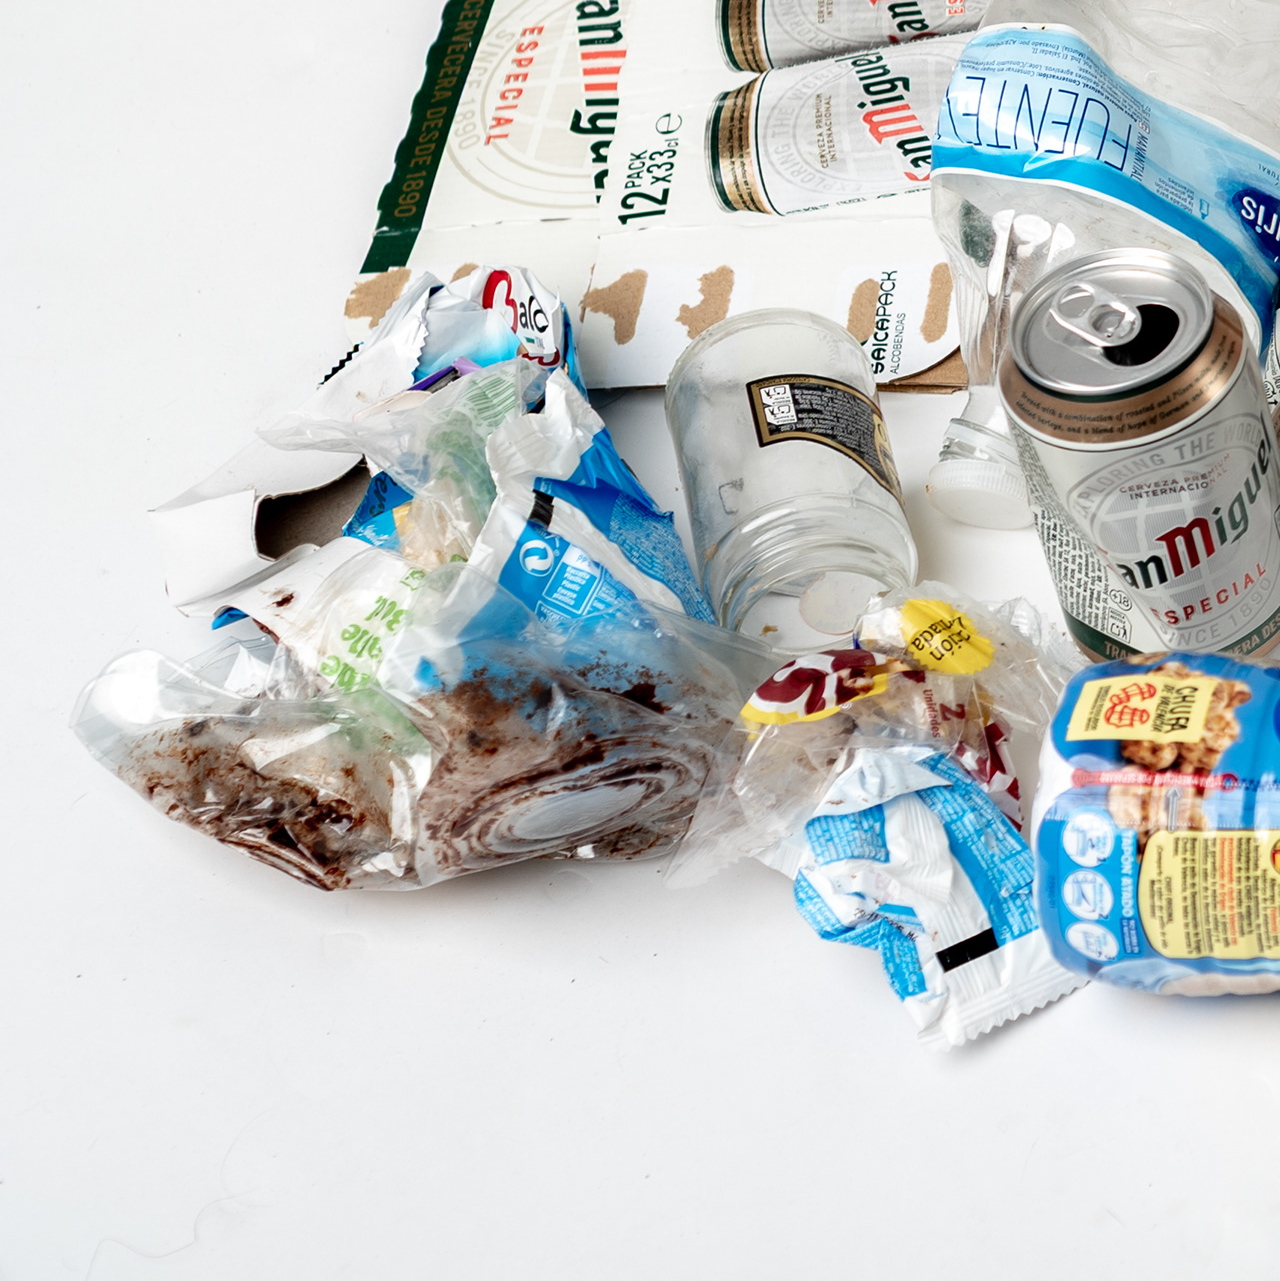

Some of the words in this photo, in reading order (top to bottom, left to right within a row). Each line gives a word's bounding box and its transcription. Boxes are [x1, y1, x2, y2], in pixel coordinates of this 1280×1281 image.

[483, 24, 545, 147] ESPECIAL
[814, 93, 824, 127] PREMIUM
[825, 95, 838, 162] INTERNACIONAL
[409, 105, 450, 170] DESDE
[819, 128, 829, 169] CERVEZA
[1134, 132, 1150, 183] MANANTIAL
[624, 149, 648, 190] PACK
[392, 168, 428, 219] 1890
[617, 186, 671, 226] 12
[871, 269, 898, 376] SAICAPACK
[890, 312, 906, 375] ALCOBENDAS
[1173, 432, 1216, 461] THE
[1118, 477, 1180, 495] CERVEZA
[1183, 452, 1232, 485] PREMIUM
[1129, 467, 1230, 502] INTERNACIONAL
[921, 688, 942, 739] Unidades
[942, 701, 966, 722] 2
[1149, 695, 1170, 734] VALENCIA
[1166, 685, 1199, 735] CHUFA
[1121, 877, 1135, 918] ATADO
